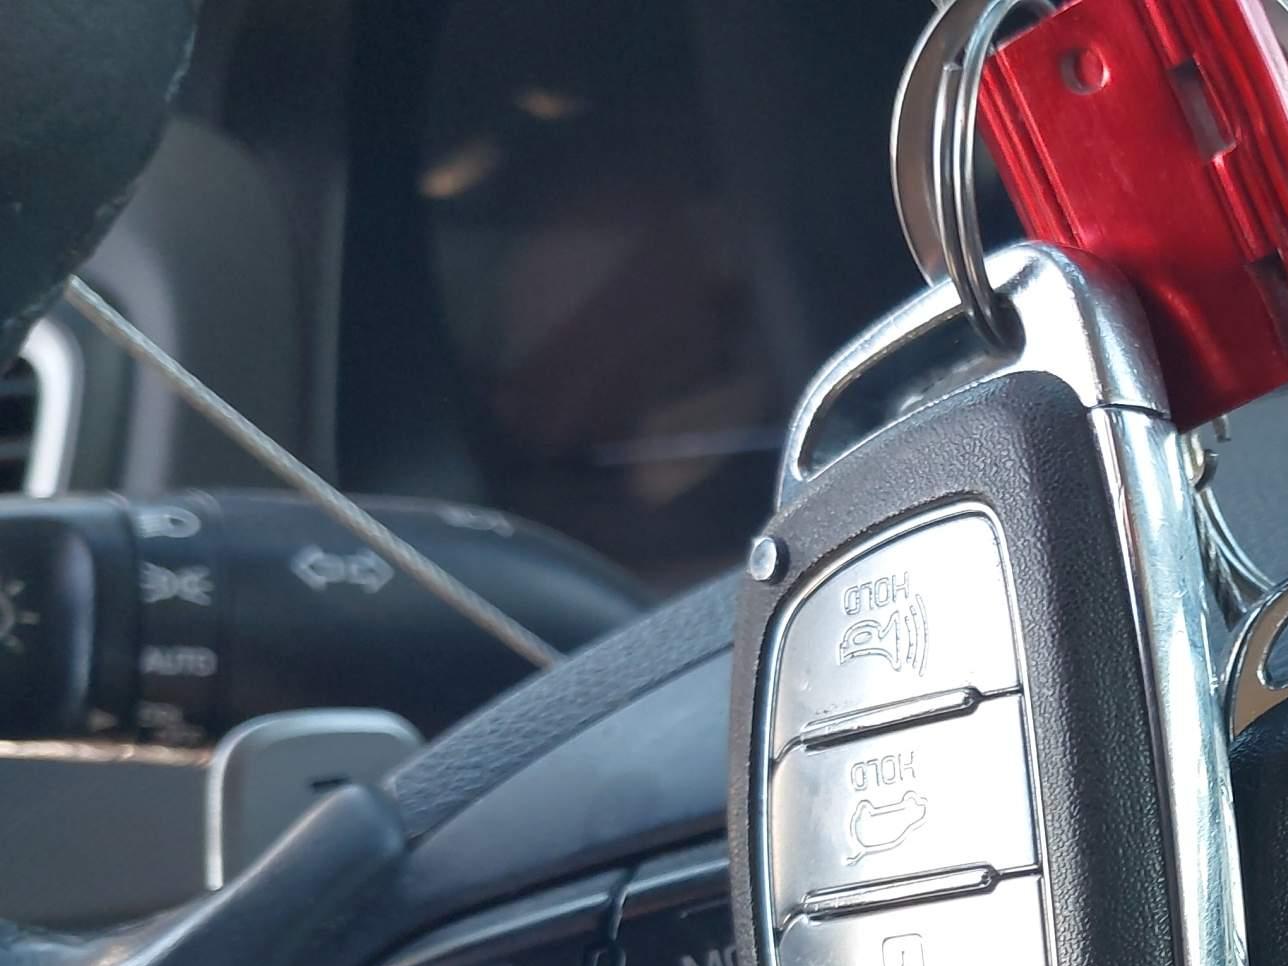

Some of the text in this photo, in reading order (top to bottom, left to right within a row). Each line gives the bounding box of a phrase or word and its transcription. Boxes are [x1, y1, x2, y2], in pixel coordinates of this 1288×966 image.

[843, 570, 911, 616] HOLD
[139, 645, 219, 677] AUTO
[850, 750, 917, 793] HOLD
